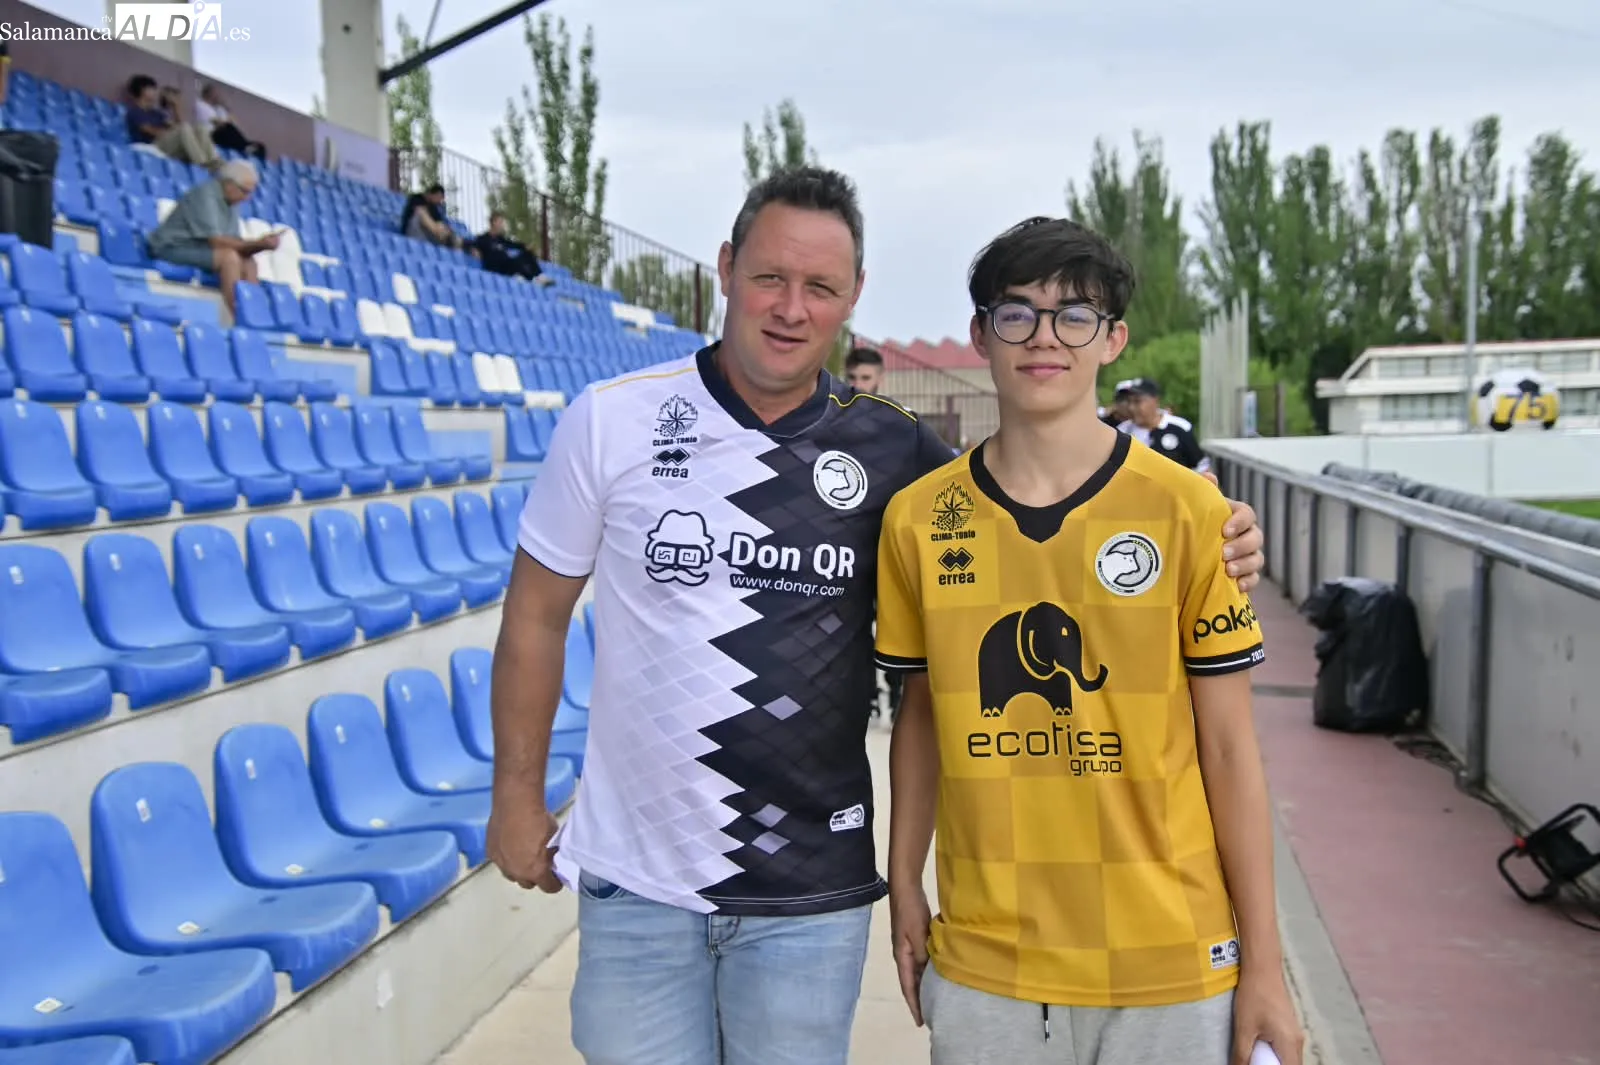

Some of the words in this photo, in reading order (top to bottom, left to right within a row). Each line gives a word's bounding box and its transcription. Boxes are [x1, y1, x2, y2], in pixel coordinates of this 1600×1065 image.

[652, 466, 689, 478] errea
[730, 532, 802, 572] Don
[812, 543, 856, 580] QR
[731, 574, 845, 597] www.donqr.com
[938, 572, 976, 585] errea
[968, 721, 1122, 757] ecotisa
[1069, 759, 1122, 777] grupo
